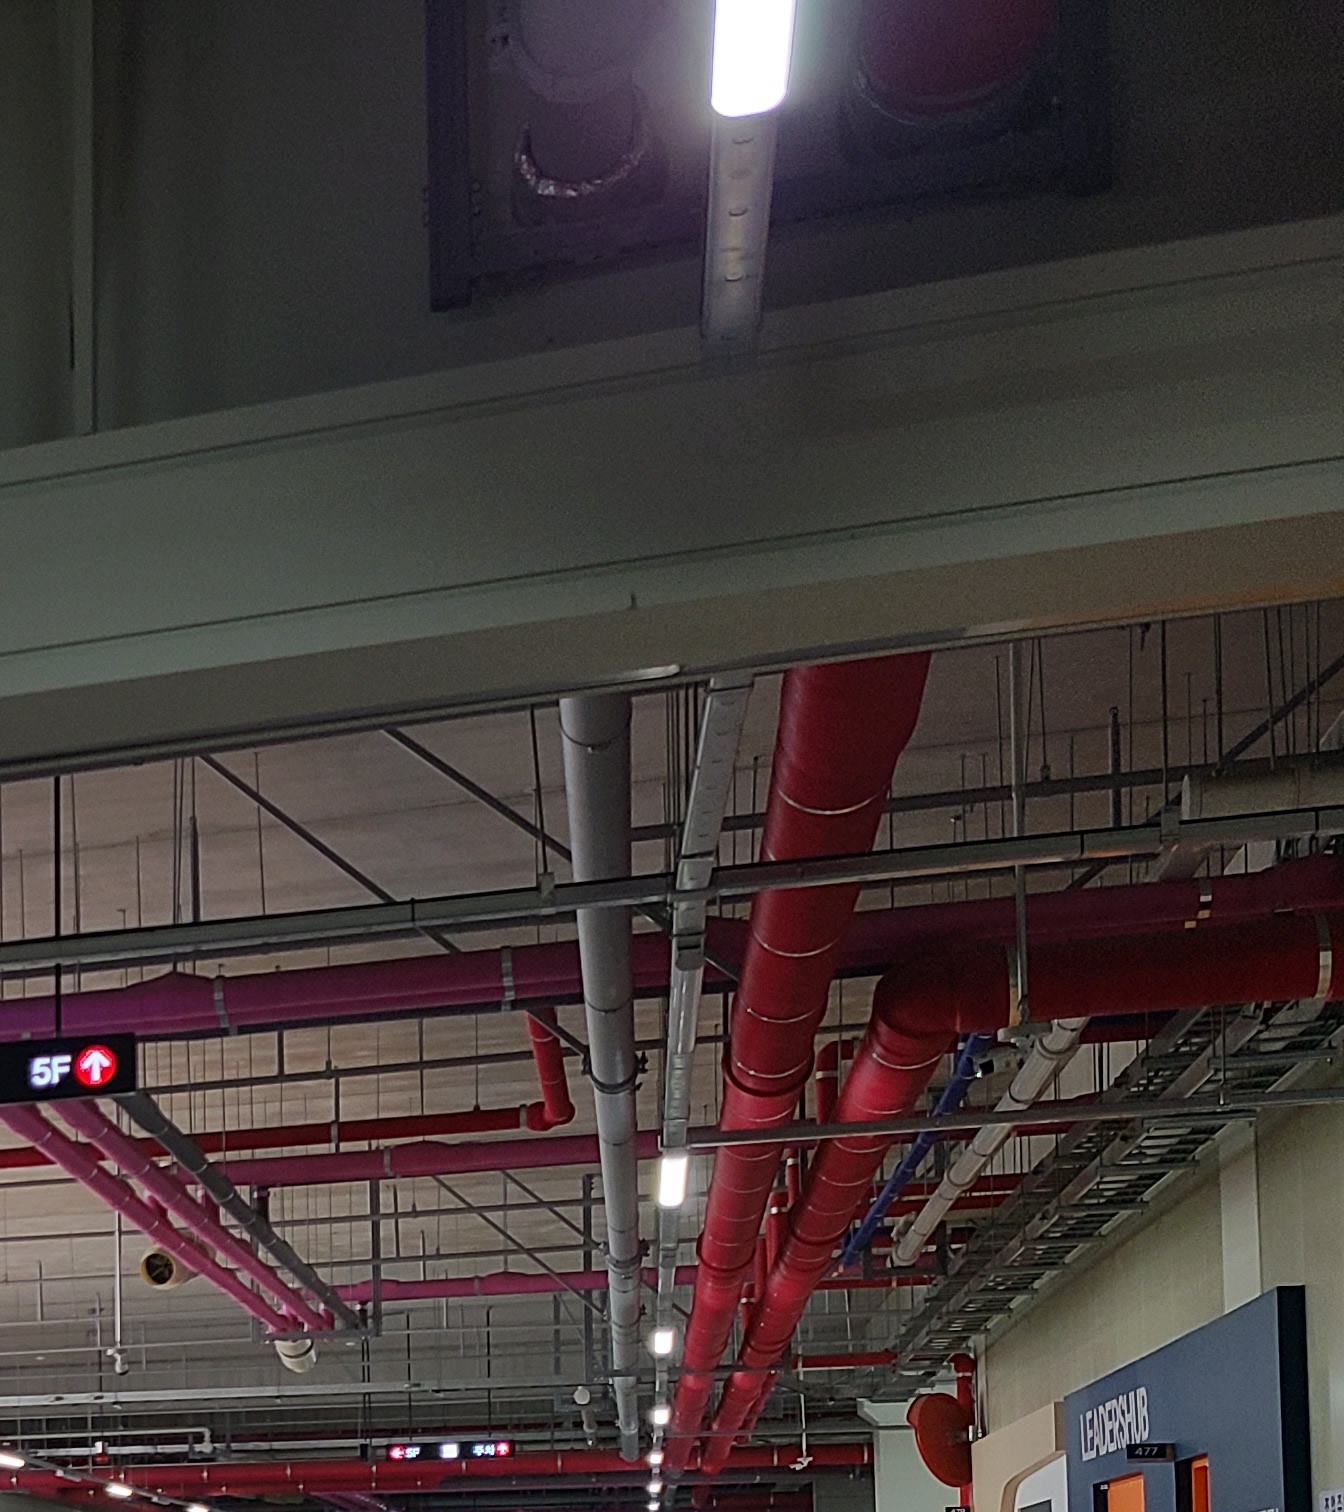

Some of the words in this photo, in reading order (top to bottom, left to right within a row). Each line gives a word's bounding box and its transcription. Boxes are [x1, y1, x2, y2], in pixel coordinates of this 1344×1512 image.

[30, 1055, 72, 1087] 5F
[1079, 1386, 1150, 1462] LEADERSHUB
[1134, 1446, 1159, 1456] 477
